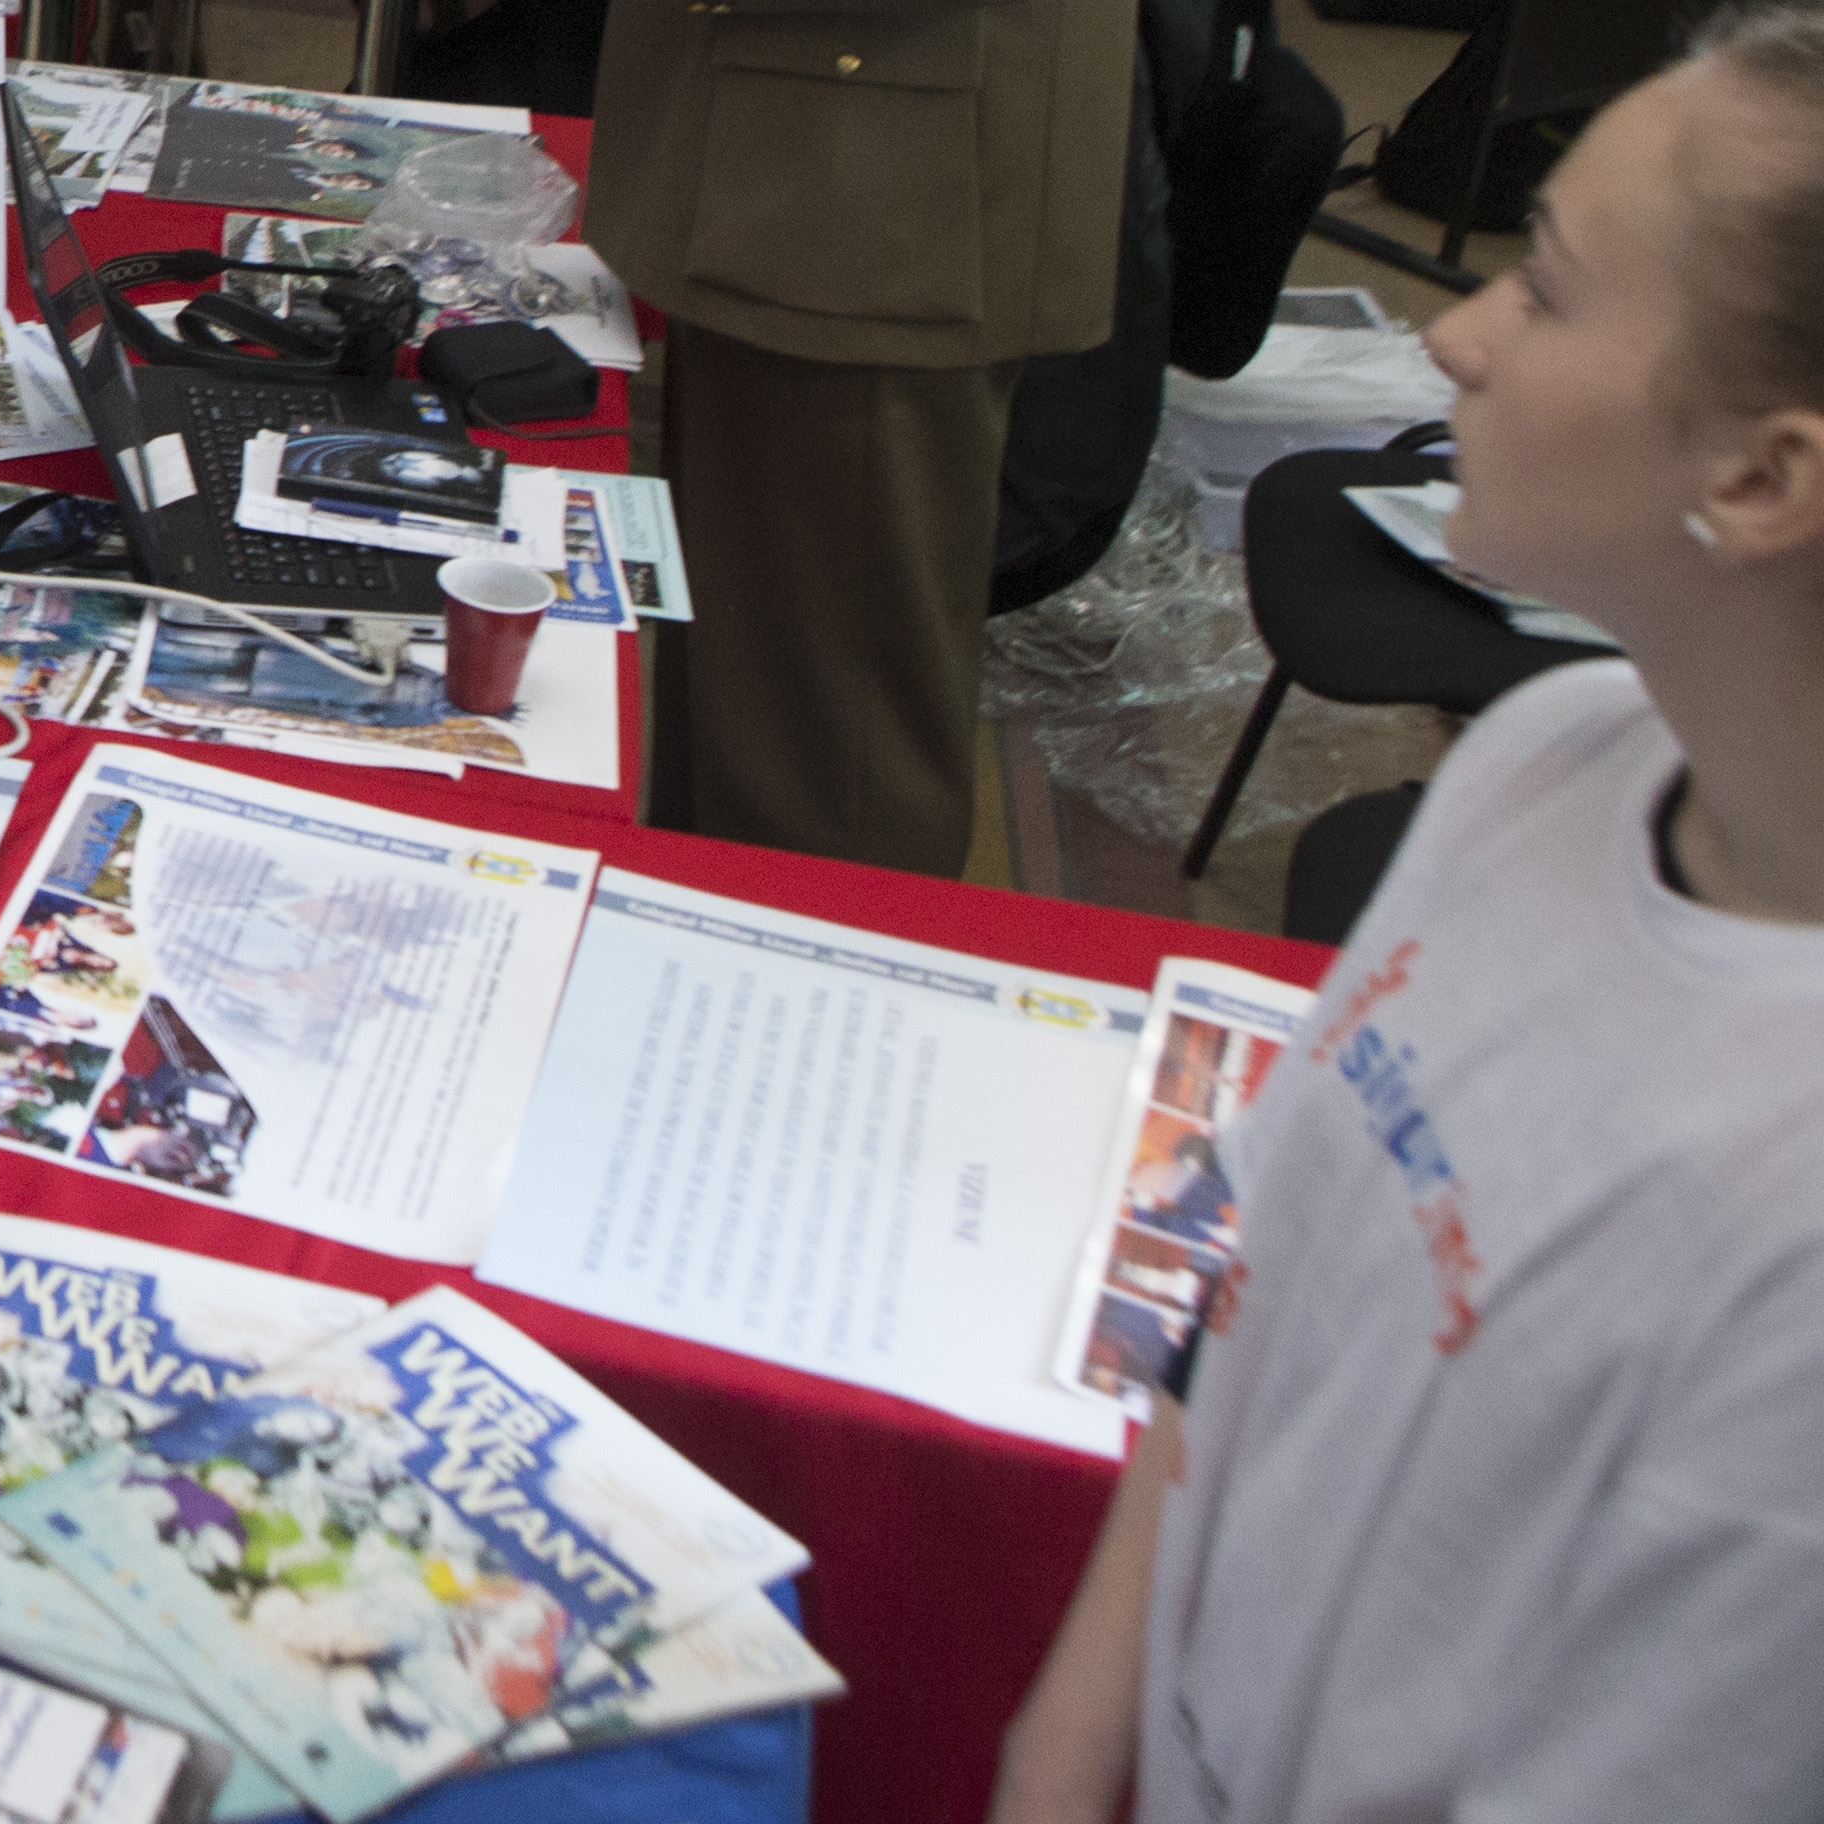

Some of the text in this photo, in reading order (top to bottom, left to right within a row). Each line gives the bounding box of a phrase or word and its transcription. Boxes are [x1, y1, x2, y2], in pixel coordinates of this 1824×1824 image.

[39, 1296, 158, 1354] WE
[400, 1328, 551, 1447] WEB
[414, 1375, 540, 1482] WE
[429, 1452, 639, 1604] WANT
